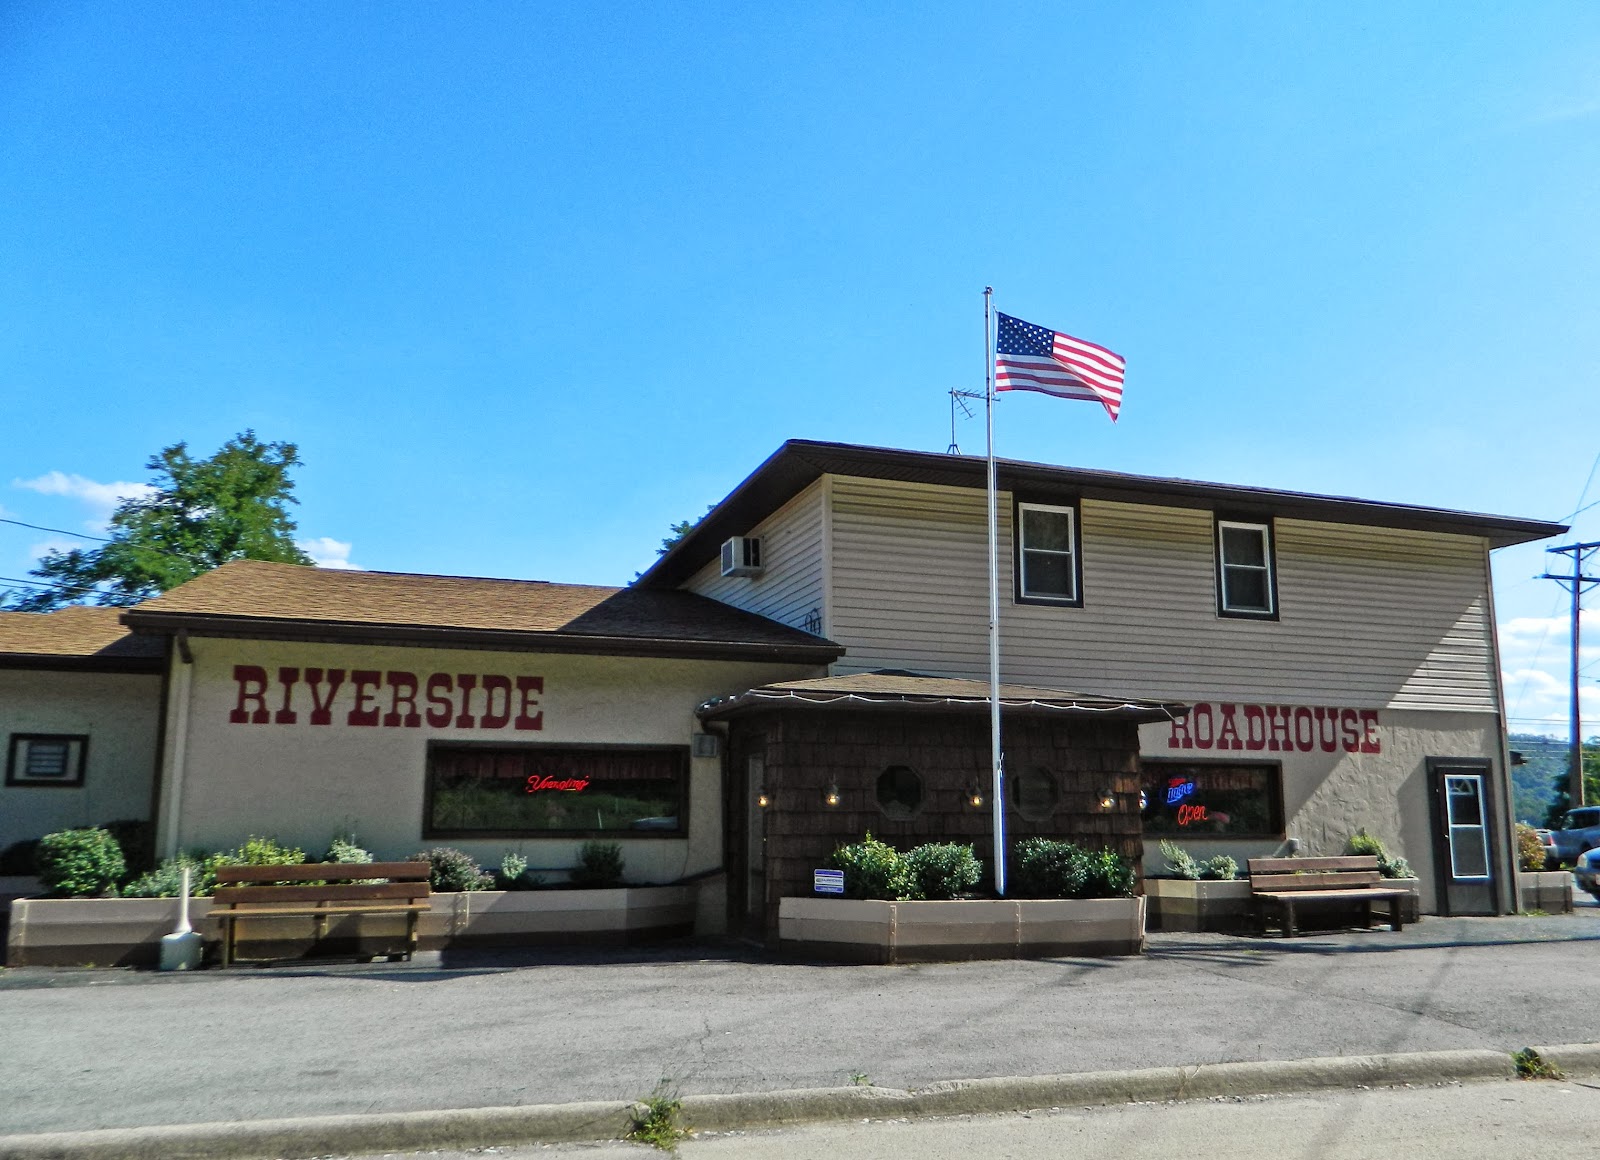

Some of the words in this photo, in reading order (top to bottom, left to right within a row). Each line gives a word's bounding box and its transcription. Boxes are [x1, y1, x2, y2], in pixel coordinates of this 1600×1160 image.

[229, 664, 545, 731] RIVERSIDE
[1168, 702, 1381, 754] ROADHOUSE
[524, 774, 589, 793] Yuengling
[1177, 804, 1208, 826] Open
